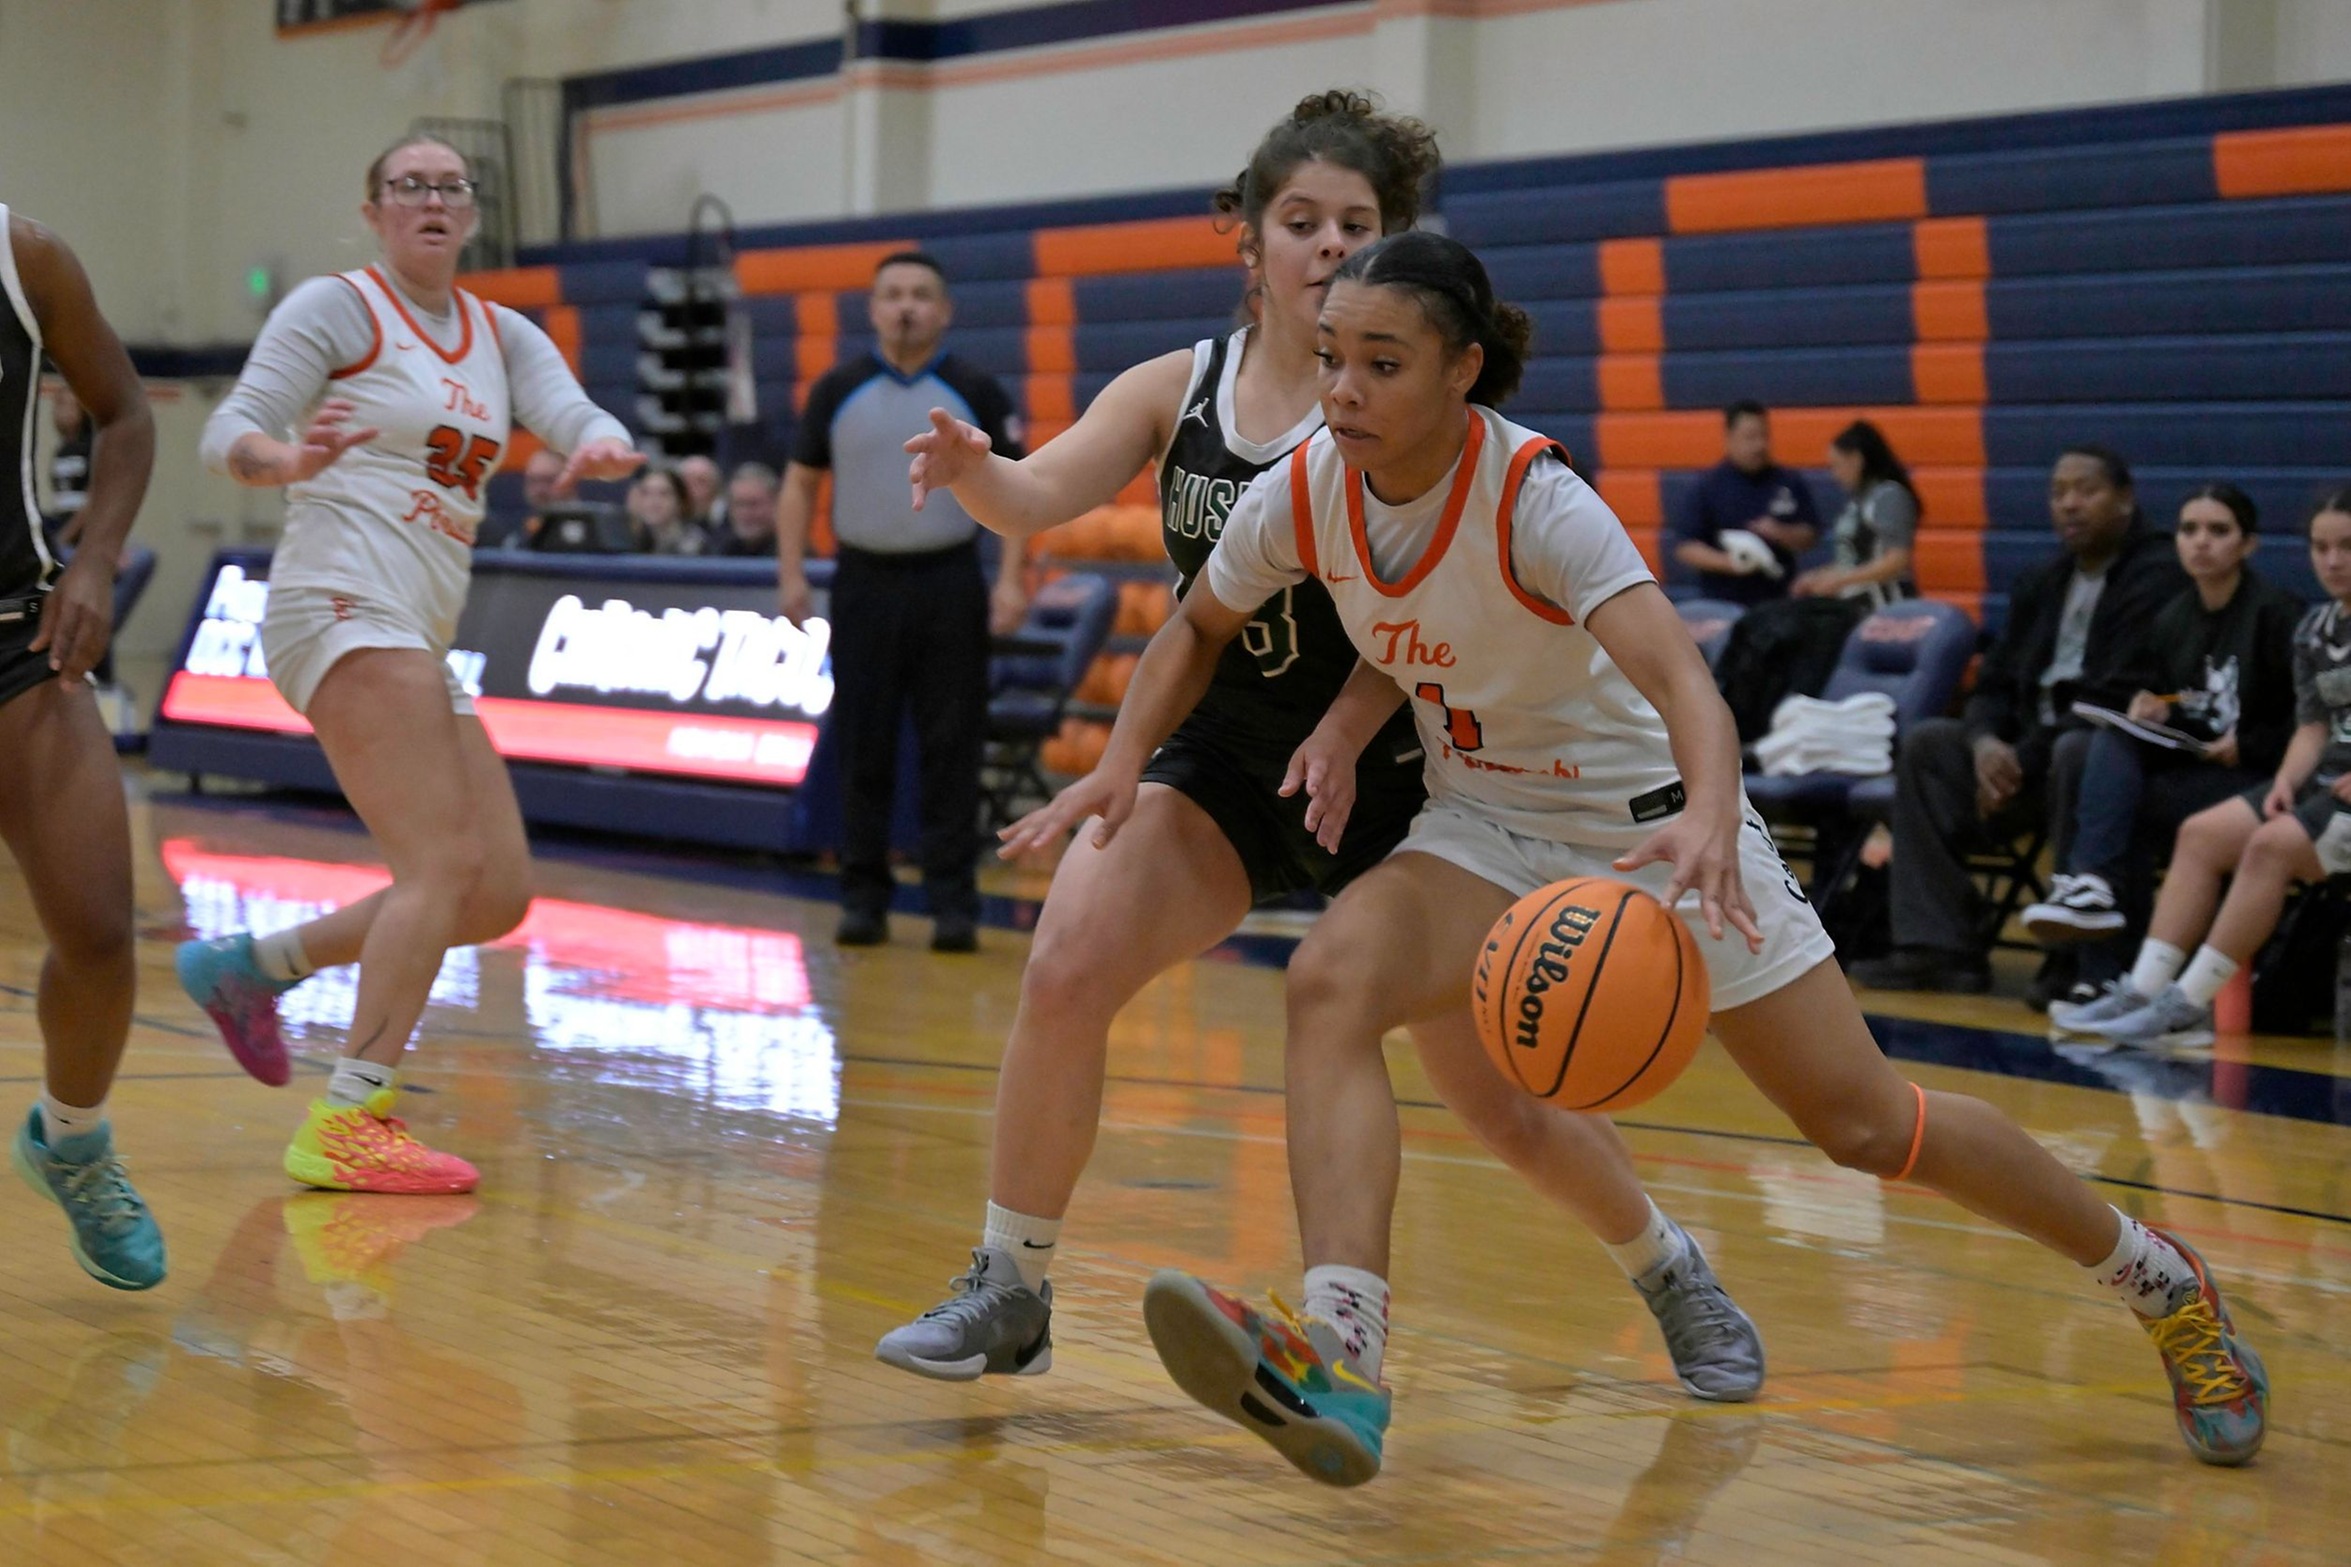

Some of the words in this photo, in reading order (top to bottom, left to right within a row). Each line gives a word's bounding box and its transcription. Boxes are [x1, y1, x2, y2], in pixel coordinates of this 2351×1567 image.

[441, 377, 491, 421] The
[426, 423, 501, 502] 25
[1166, 464, 1252, 543] HUS
[1371, 618, 1457, 668] The
[1671, 789, 1684, 803] M
[1516, 904, 1602, 1049] Wilson
